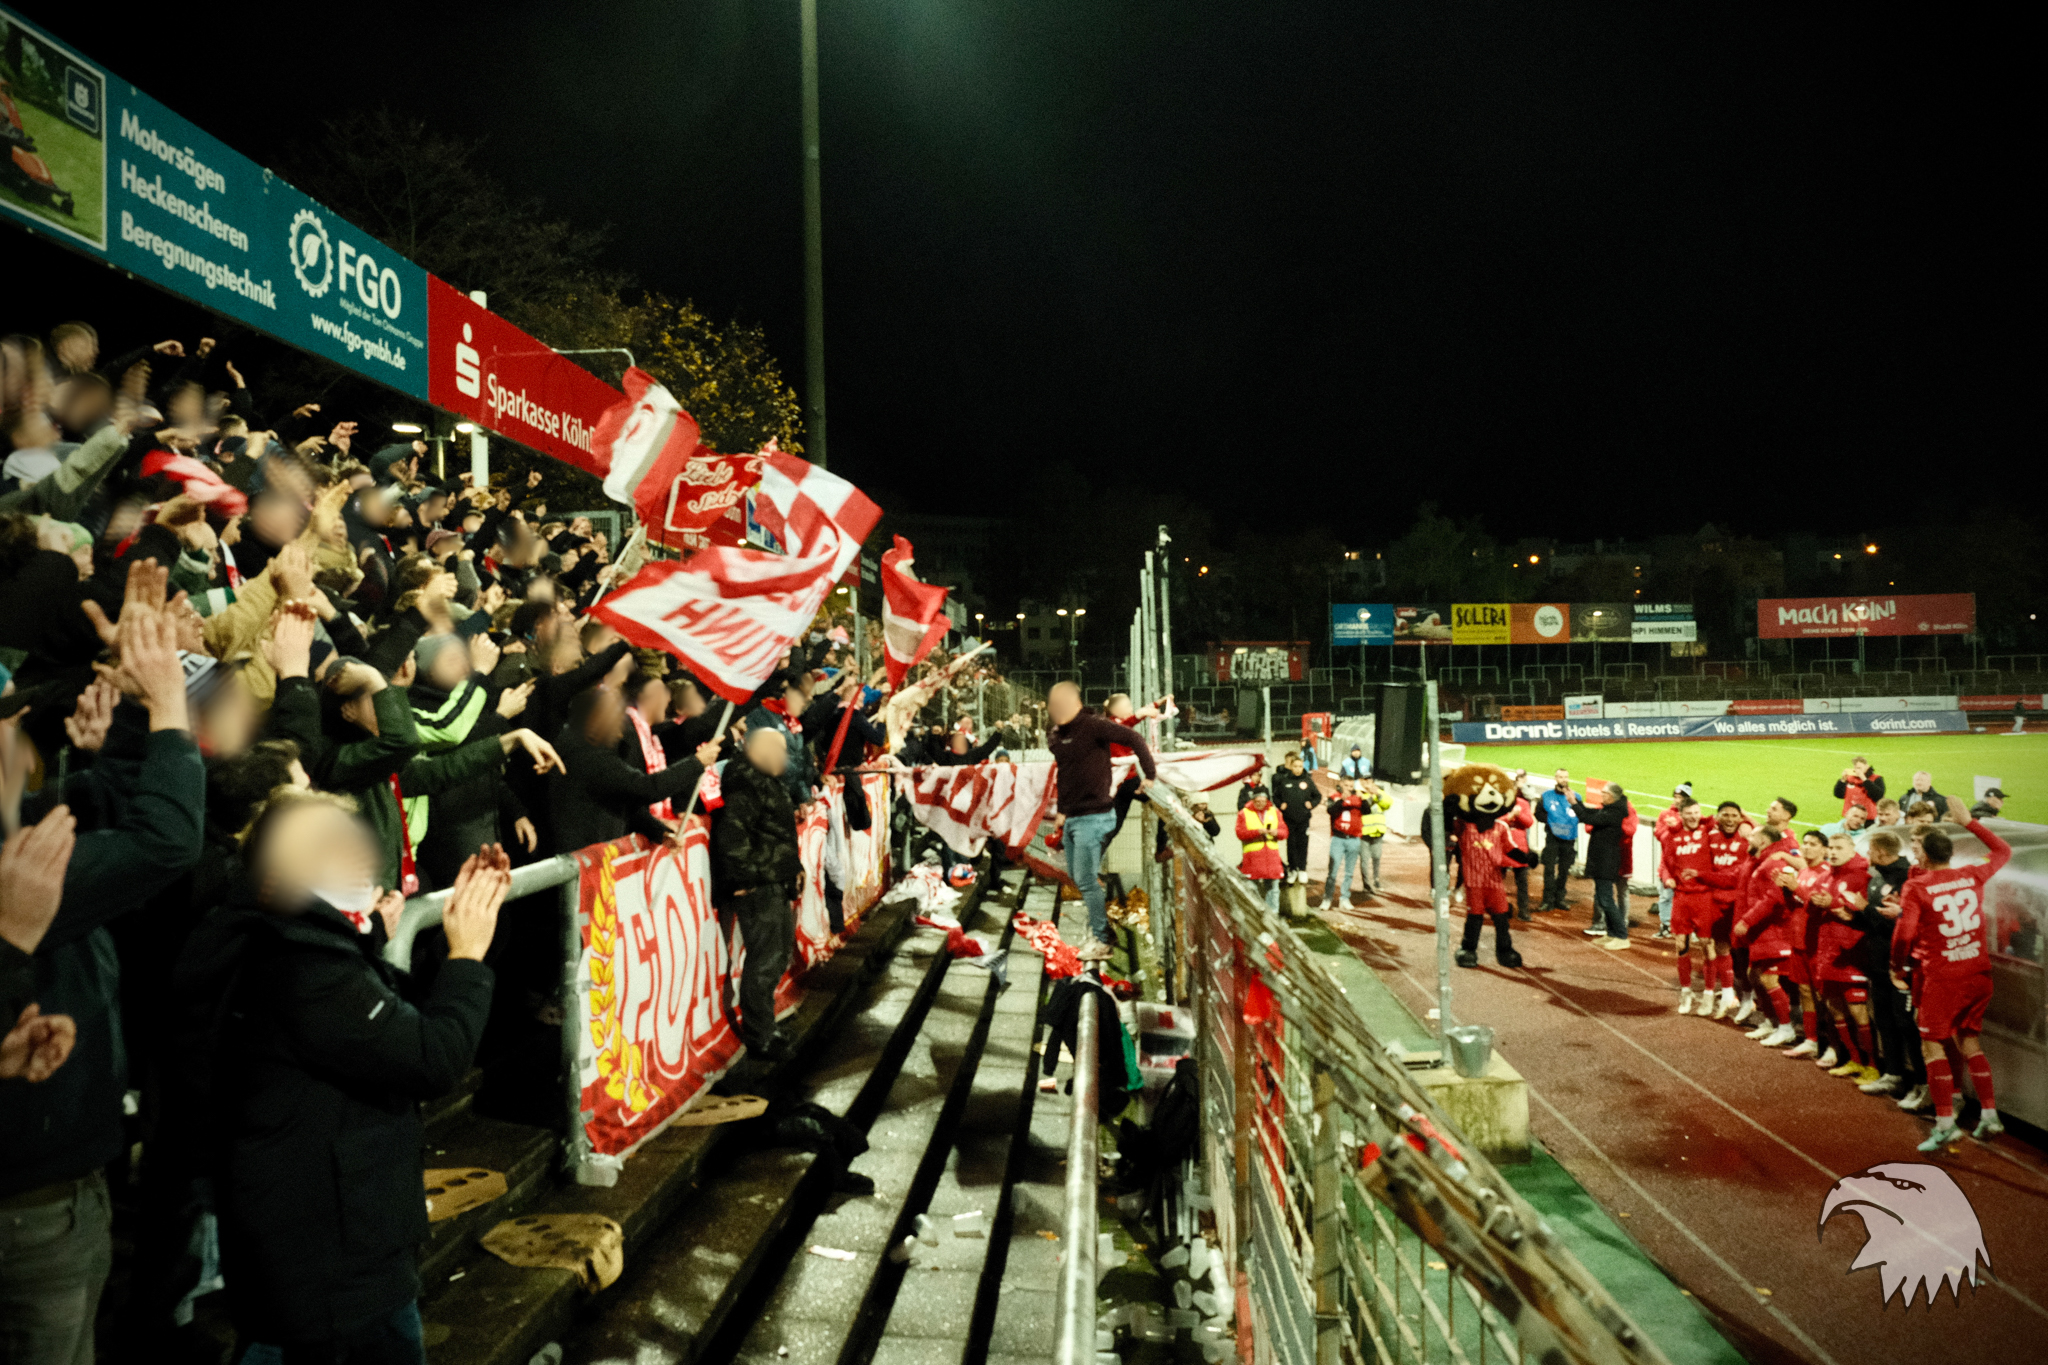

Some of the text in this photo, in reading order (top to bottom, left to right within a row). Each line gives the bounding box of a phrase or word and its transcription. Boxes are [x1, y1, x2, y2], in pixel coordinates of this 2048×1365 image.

[120, 108, 225, 194] Motorsägen
[121, 159, 249, 252] Heckenscheren
[121, 210, 277, 310] Beregnungstechnik
[338, 239, 402, 320] FGO
[311, 312, 406, 371] www.fgo-gmbh.de
[487, 372, 560, 438] Sparkasse
[1631, 627, 1647, 635] HPI
[1648, 626, 1682, 635] HIMMEN
[1633, 603, 1673, 614] WILMS
[1485, 718, 1937, 739] Dorint Hotels & Resorts Wo alles möglich ist. dorint.com
[1932, 888, 1981, 938] 32
